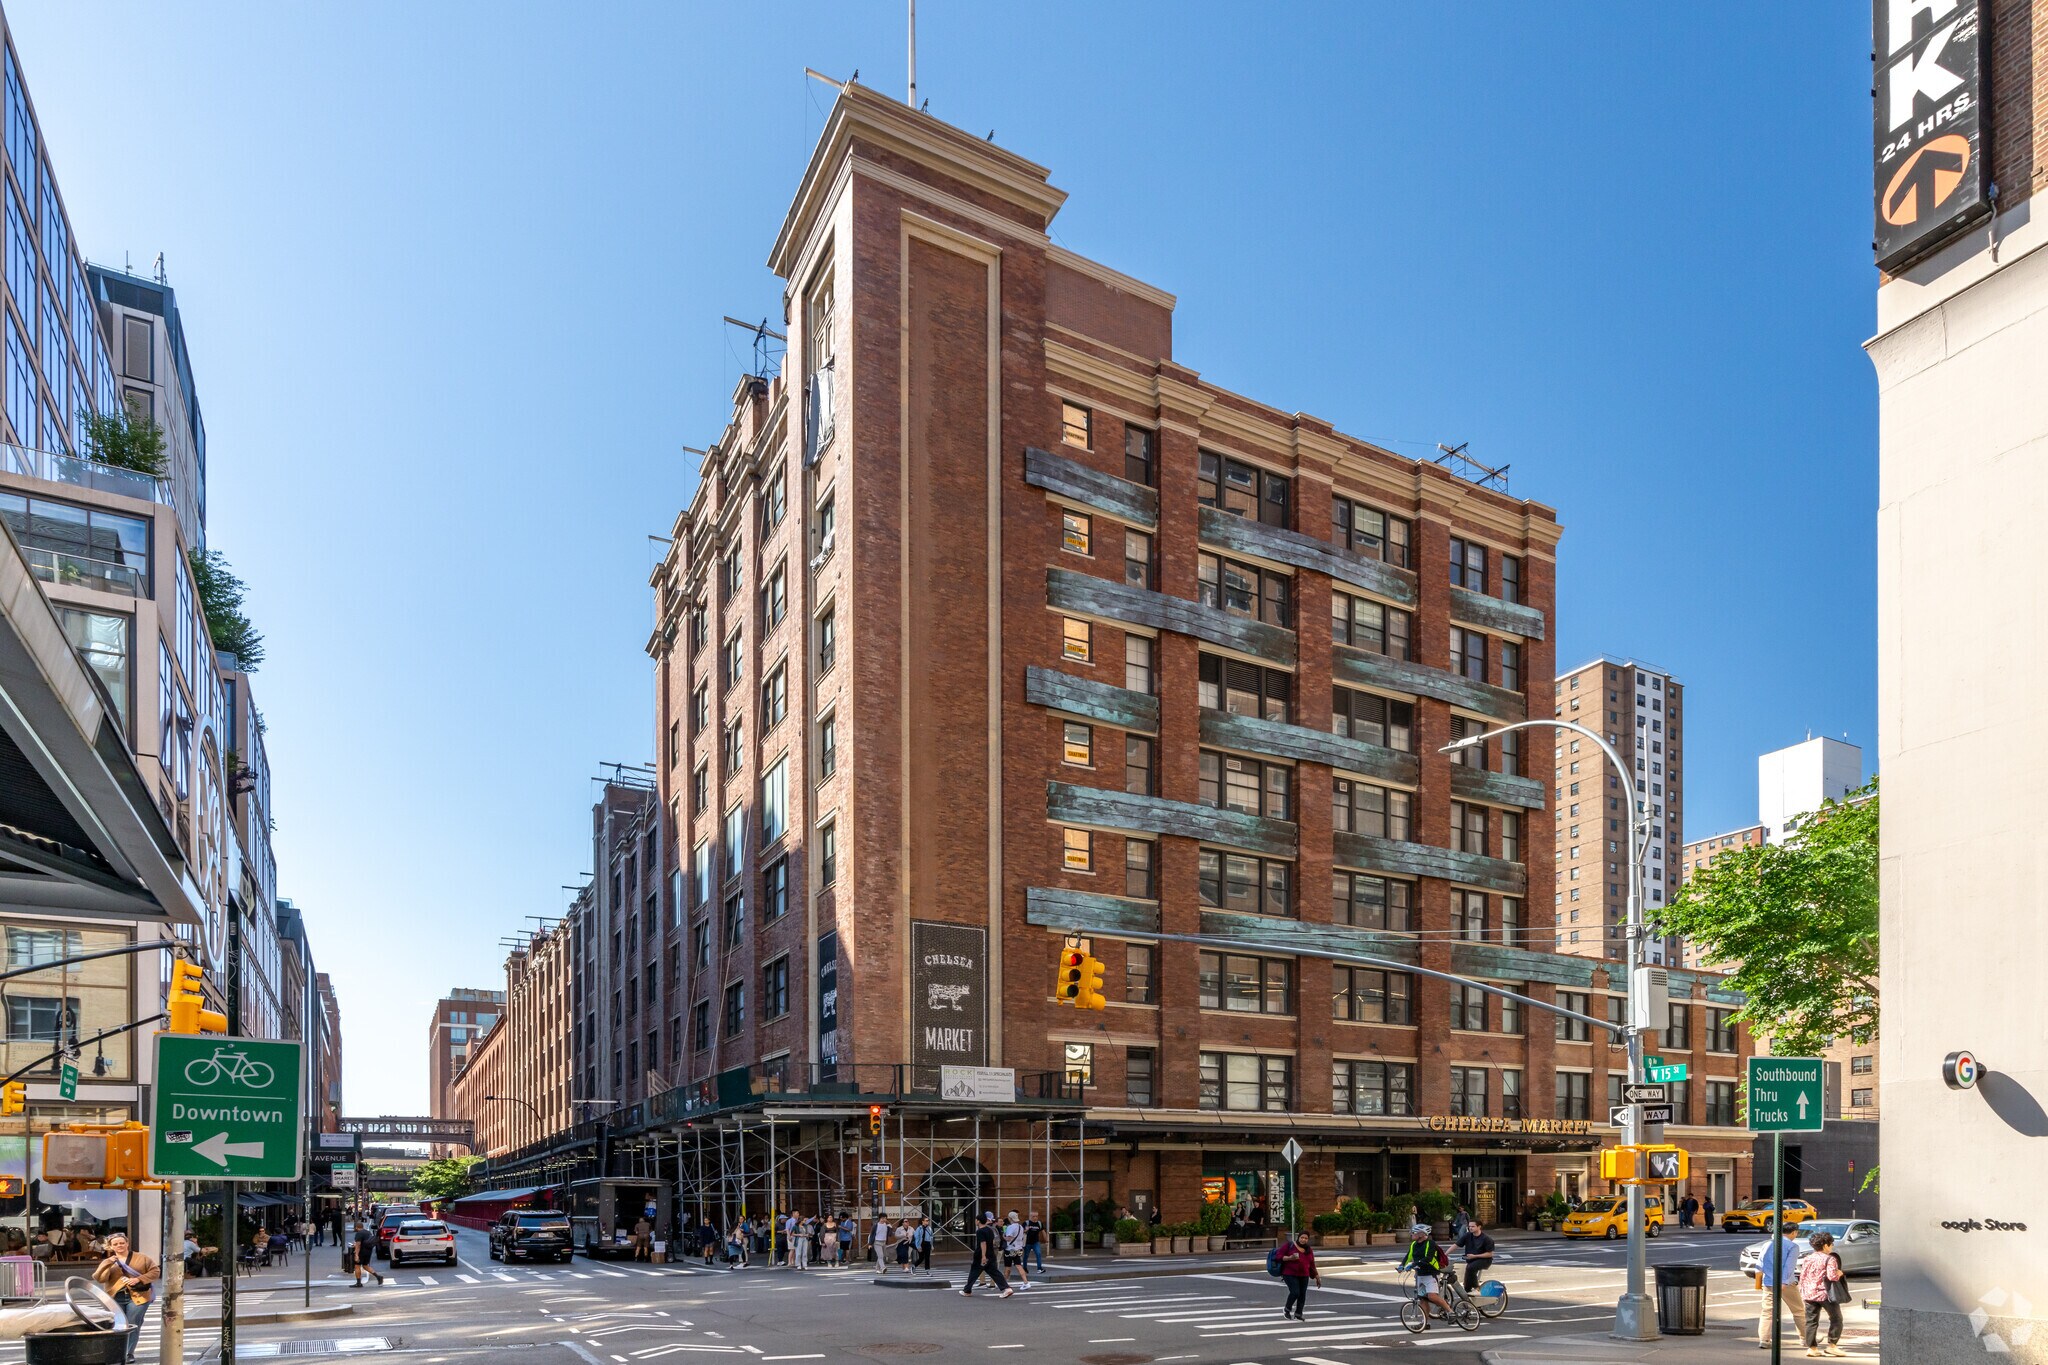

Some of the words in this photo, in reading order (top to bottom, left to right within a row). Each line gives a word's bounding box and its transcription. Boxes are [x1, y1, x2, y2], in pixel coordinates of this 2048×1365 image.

[1881, 131, 1911, 164] 24
[1917, 92, 1970, 139] HRS
[924, 954, 973, 969] CHELSEA
[925, 1026, 973, 1052] MARKET
[1648, 1058, 1653, 1068] 9
[1959, 1057, 1974, 1083] G
[1651, 1069, 1658, 1081] W
[1661, 1067, 1671, 1080] 15
[1673, 1066, 1680, 1074] St
[1755, 1067, 1817, 1082] Southbound
[1629, 1090, 1642, 1098] ONE
[1647, 1090, 1660, 1098] WAY
[1754, 1087, 1778, 1102] Thru
[172, 1103, 283, 1123] Downtown
[1646, 1110, 1665, 1119] WAY
[1754, 1108, 1788, 1123] Trucks
[1429, 1115, 1512, 1132] CHELSEA
[1521, 1118, 1594, 1135] MARKET
[1270, 1176, 1280, 1223] PESCADO
[1984, 1218, 2027, 1232] Store
